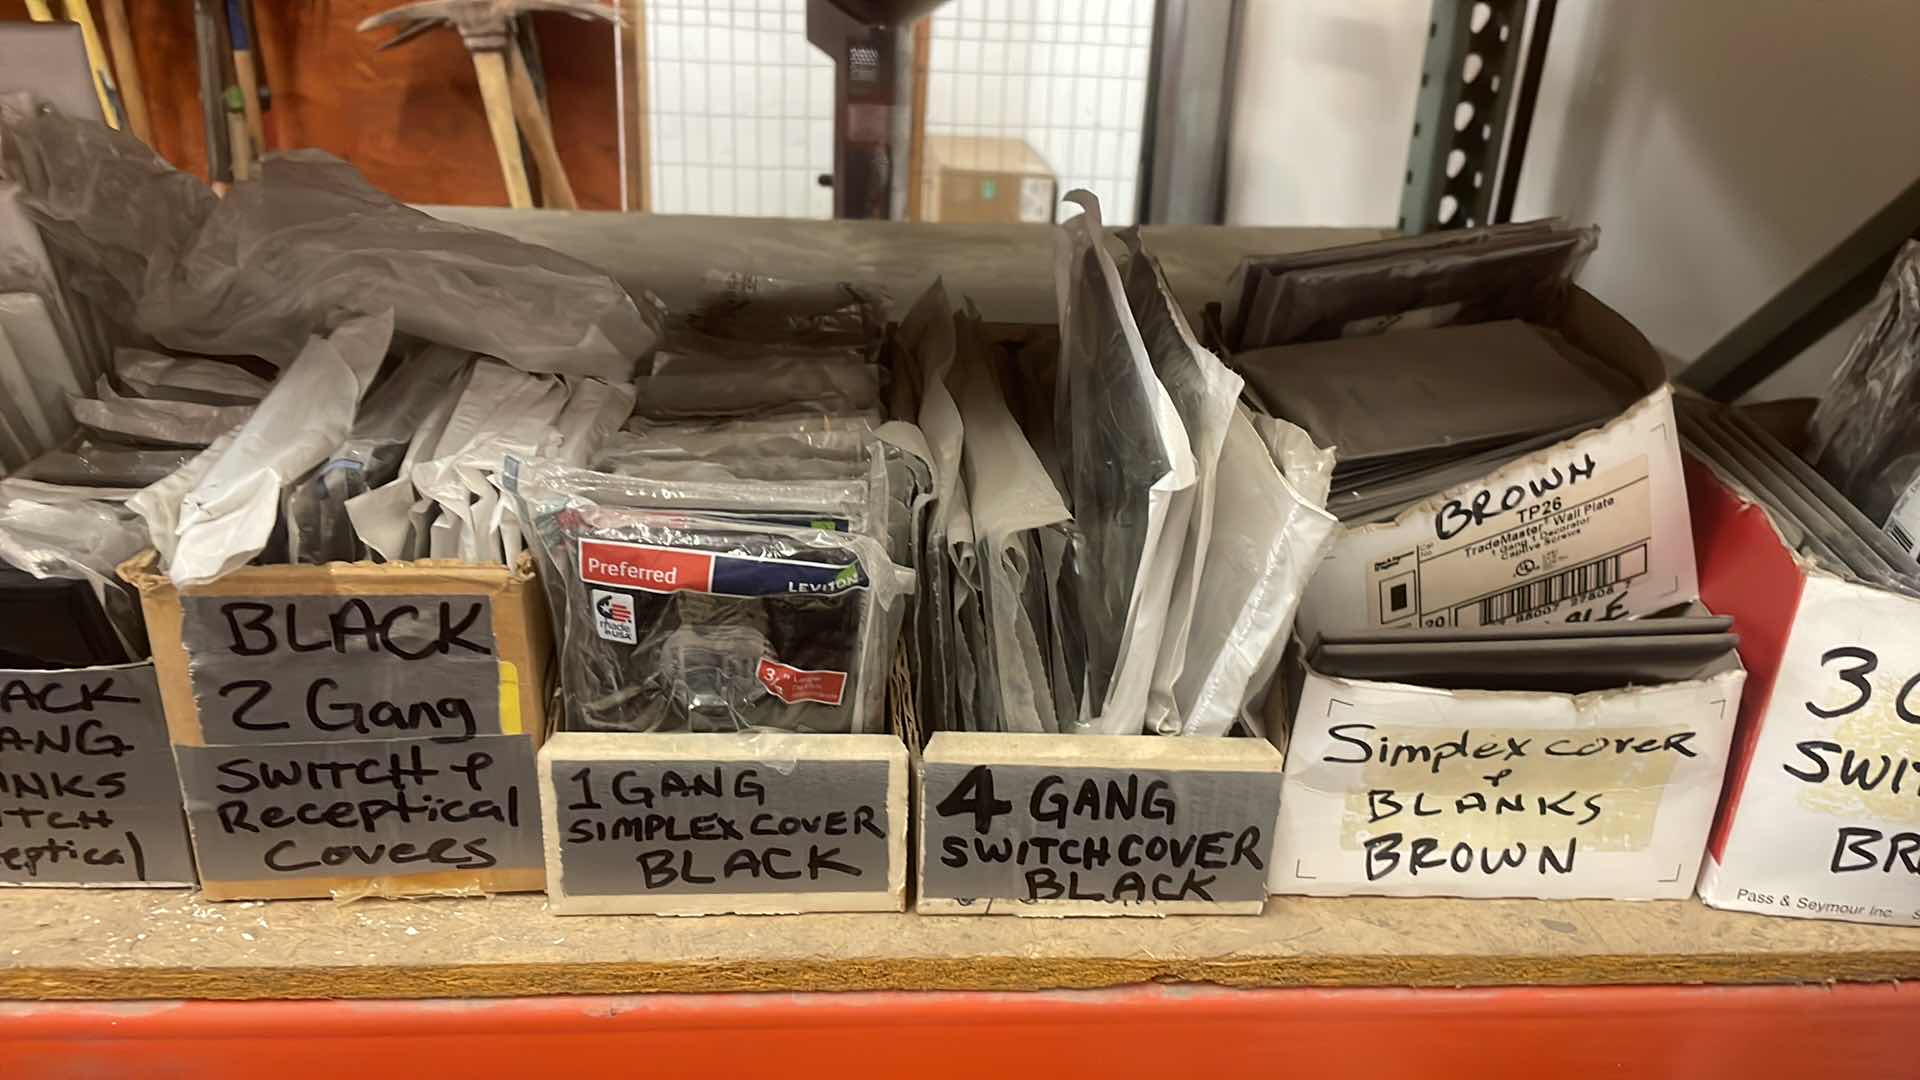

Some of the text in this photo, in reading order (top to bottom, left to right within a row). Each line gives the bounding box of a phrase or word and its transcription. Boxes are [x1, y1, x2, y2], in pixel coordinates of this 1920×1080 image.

[1435, 454, 1596, 540] BROWN
[1516, 496, 1563, 523] TP26
[1552, 509, 1581, 526] Wall
[1584, 496, 1615, 516] Plate
[588, 557, 677, 585] Preferred
[788, 573, 859, 593] LEVITON
[221, 598, 492, 660] BLACK
[1805, 646, 1879, 719] 3
[218, 678, 477, 743] 2 Gang
[216, 745, 439, 794] SWITCH
[1323, 723, 1532, 773] Simplex
[217, 785, 519, 833] Receptical
[568, 767, 766, 810] 1 GANG
[936, 765, 1176, 835] 4 GANG
[1367, 789, 1603, 826] BLANKS
[568, 806, 887, 844] SIMPLEX COVER
[637, 845, 863, 889] BLACK
[941, 825, 1265, 871] SWITCH COVER
[1363, 832, 1577, 882] BROWN
[1025, 868, 1218, 903] BLACK
[1736, 888, 1774, 905] Pass
[1780, 895, 1790, 907] &
[1796, 896, 1865, 915] Seymour
